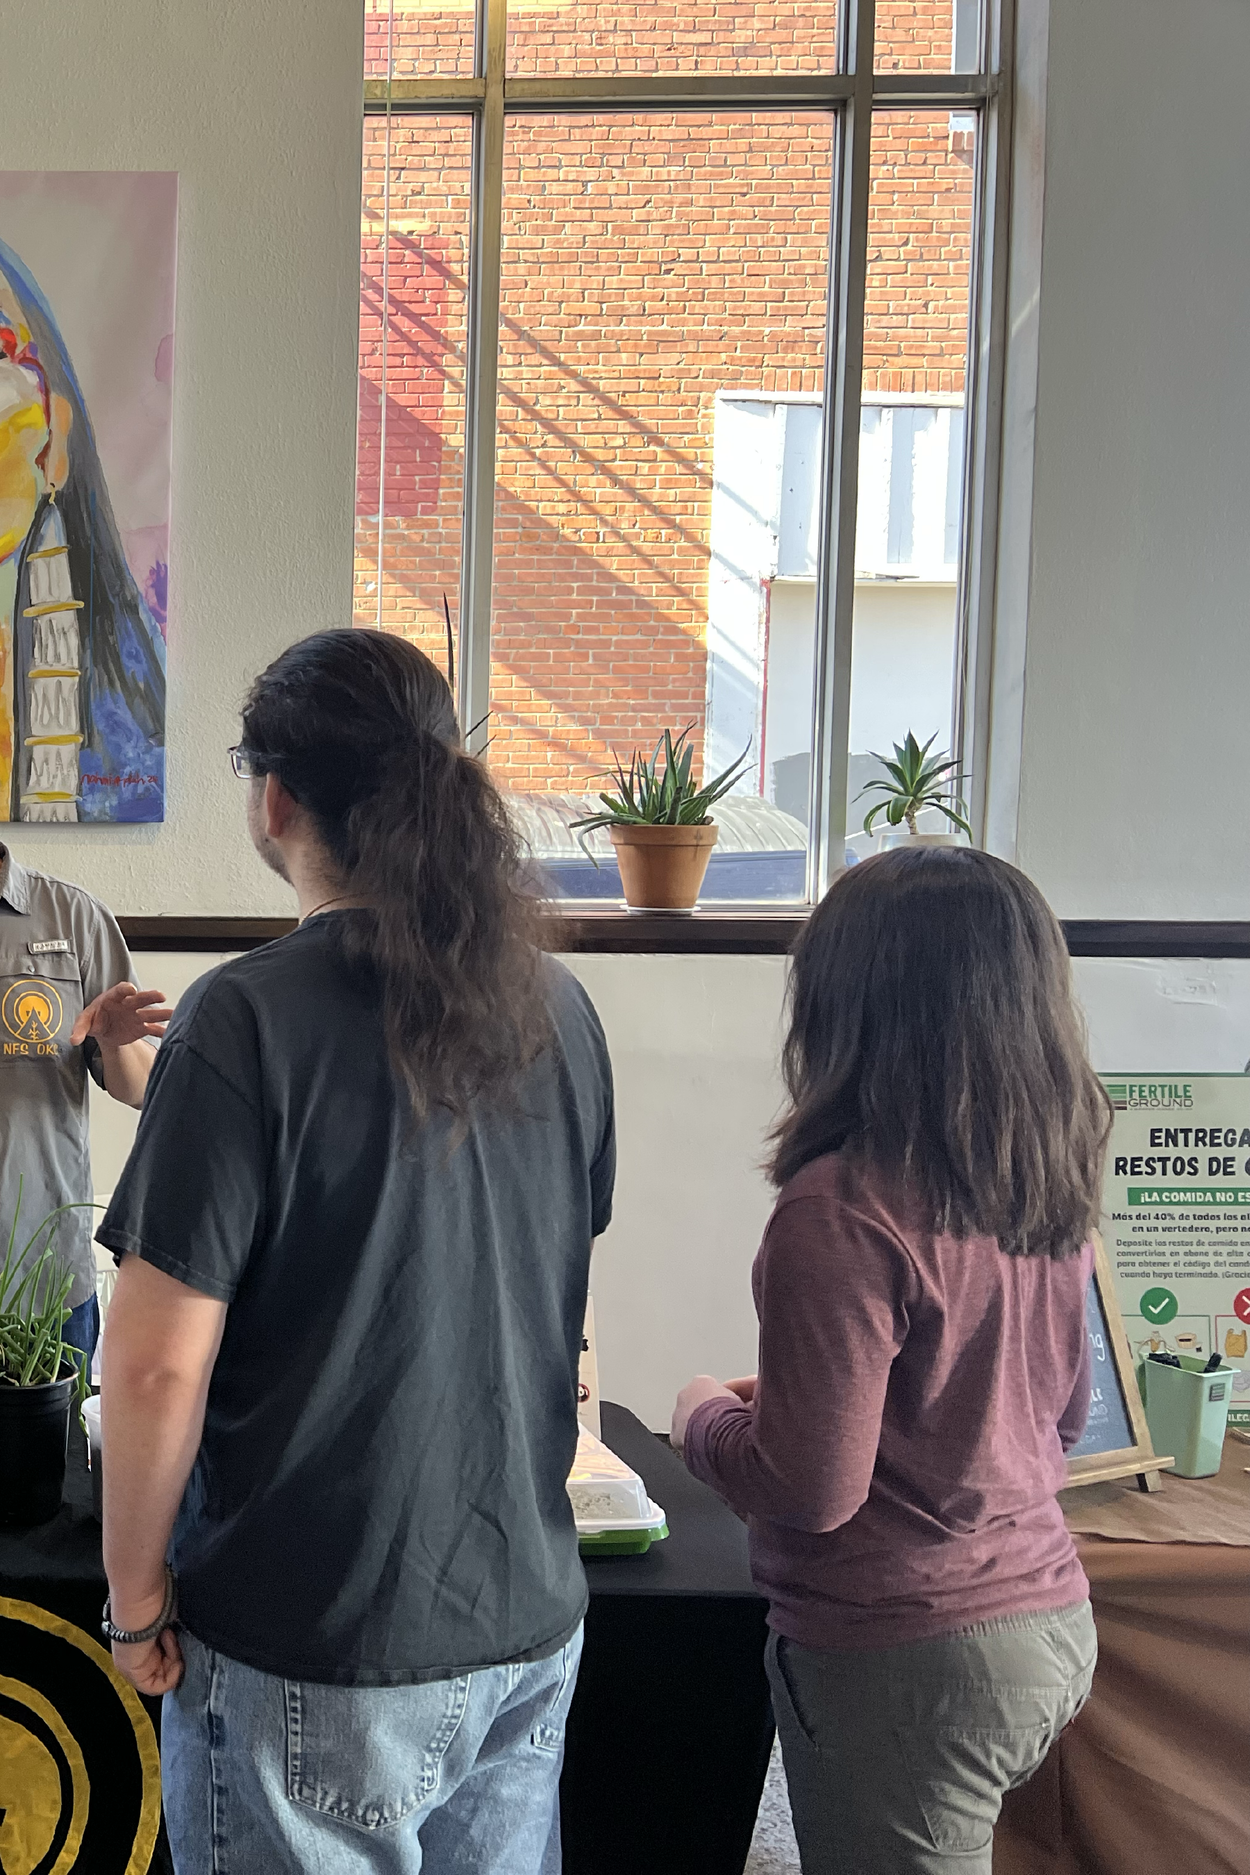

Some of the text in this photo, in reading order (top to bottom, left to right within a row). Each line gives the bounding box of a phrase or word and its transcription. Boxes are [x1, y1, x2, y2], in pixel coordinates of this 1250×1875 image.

[3, 1043, 29, 1055] NFS
[1128, 1084, 1193, 1098] FERTILE
[1128, 1098, 1194, 1107] GROUND
[1150, 1128, 1250, 1147] ENTREGA
[1114, 1156, 1199, 1176] RESTOS
[1208, 1156, 1236, 1176] DE
[1162, 1192, 1214, 1202] COMIDA
[1216, 1192, 1234, 1202] NO
[1112, 1211, 1133, 1221] Más
[1135, 1212, 1151, 1221] del
[1153, 1213, 1176, 1221] 40%
[1179, 1213, 1190, 1221] de
[1193, 1213, 1221, 1221] todos
[1223, 1212, 1238, 1221] los
[1161, 1225, 1214, 1234] vertedero,
[1215, 1226, 1239, 1234] pero
[1116, 1239, 1153, 1248] Deposite
